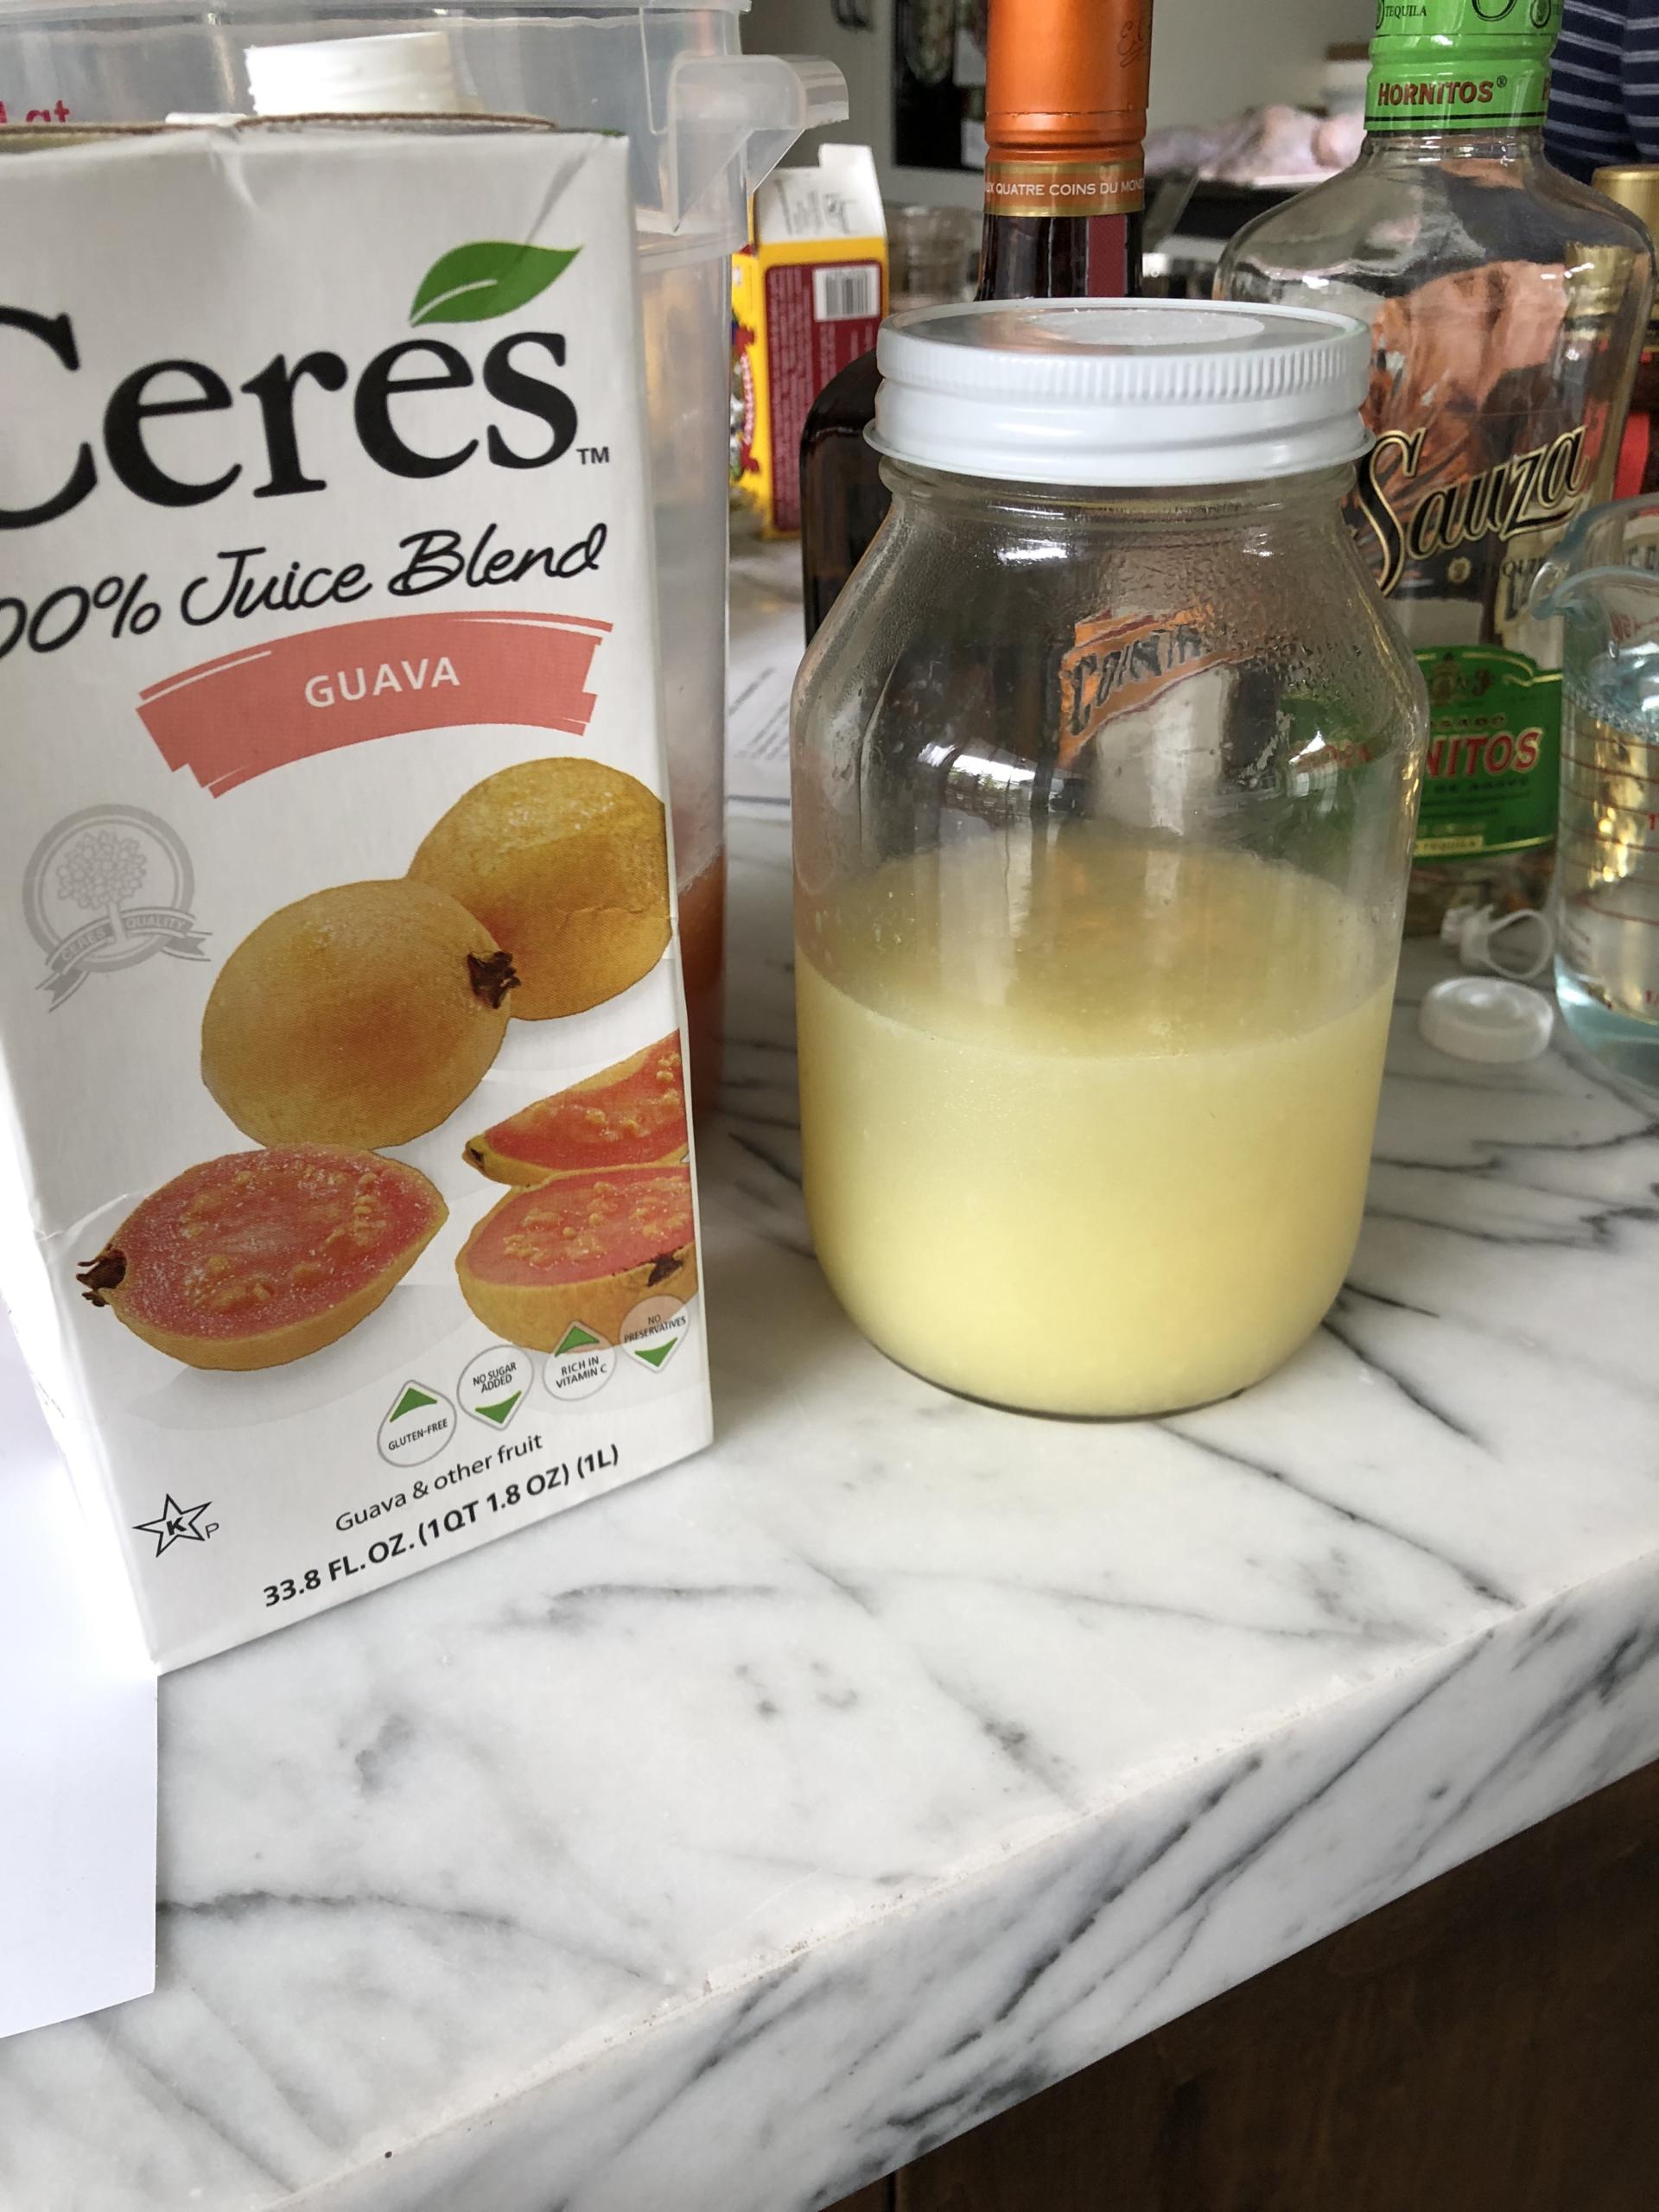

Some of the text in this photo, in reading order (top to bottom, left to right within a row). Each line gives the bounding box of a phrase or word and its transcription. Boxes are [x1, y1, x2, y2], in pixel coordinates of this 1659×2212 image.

[1385, 4, 1427, 18] TEQUILA
[995, 182, 1045, 196] QUATRE
[1048, 183, 1096, 196] COINS
[1099, 181, 1118, 194] DU
[1357, 423, 1590, 598] Sauza
[181, 546, 373, 627] Juice
[387, 523, 607, 597] Blend
[305, 657, 461, 709] GUAVA
[125, 915, 187, 931] QUALITY
[623, 1315, 687, 1344] PRESERVATIVES
[647, 1313, 661, 1325] NO
[472, 1361, 518, 1387] NO SUGAR
[556, 1363, 608, 1389] VITAMIN C
[561, 1356, 600, 1376] RICH IN
[480, 1374, 513, 1394] ADDED
[388, 1418, 448, 1452] GLUTEN-FREE
[334, 1434, 543, 1532] Guava & other fruit
[167, 1516, 219, 1539] K P
[263, 1443, 619, 1607] 33.8 FL. OZ. (1QT 1.8 OZ) (1L)
